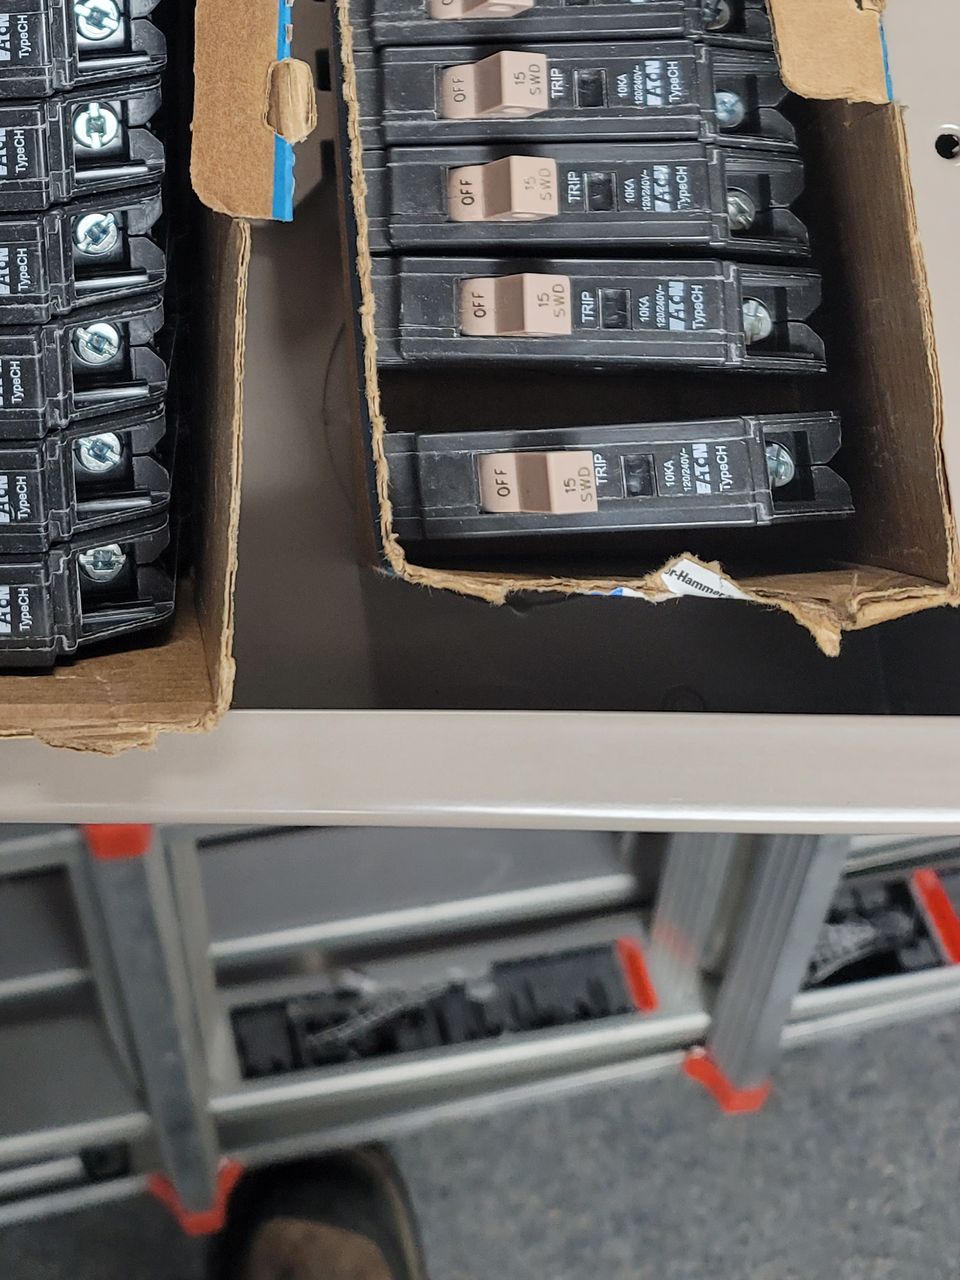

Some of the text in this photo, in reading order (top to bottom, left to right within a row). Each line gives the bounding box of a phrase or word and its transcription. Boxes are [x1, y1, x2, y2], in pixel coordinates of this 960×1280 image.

[453, 77, 466, 103] OFF
[514, 71, 526, 86] 15
[529, 63, 541, 97] SWD
[551, 69, 562, 98] TRIP
[618, 75, 628, 98] 10KA
[461, 179, 475, 206] OFF
[569, 172, 580, 202] TRIP
[625, 179, 634, 203] 10KA
[473, 291, 486, 318] OFF
[538, 293, 550, 308] 15
[553, 283, 566, 318] SWD
[582, 292, 594, 323] TRIP
[640, 296, 649, 322] 10KA
[594, 453, 606, 484] TRIP
[665, 460, 675, 486] 10KA
[495, 468, 511, 497] OFF
[565, 478, 577, 493] 15
[580, 466, 592, 501] SWD
